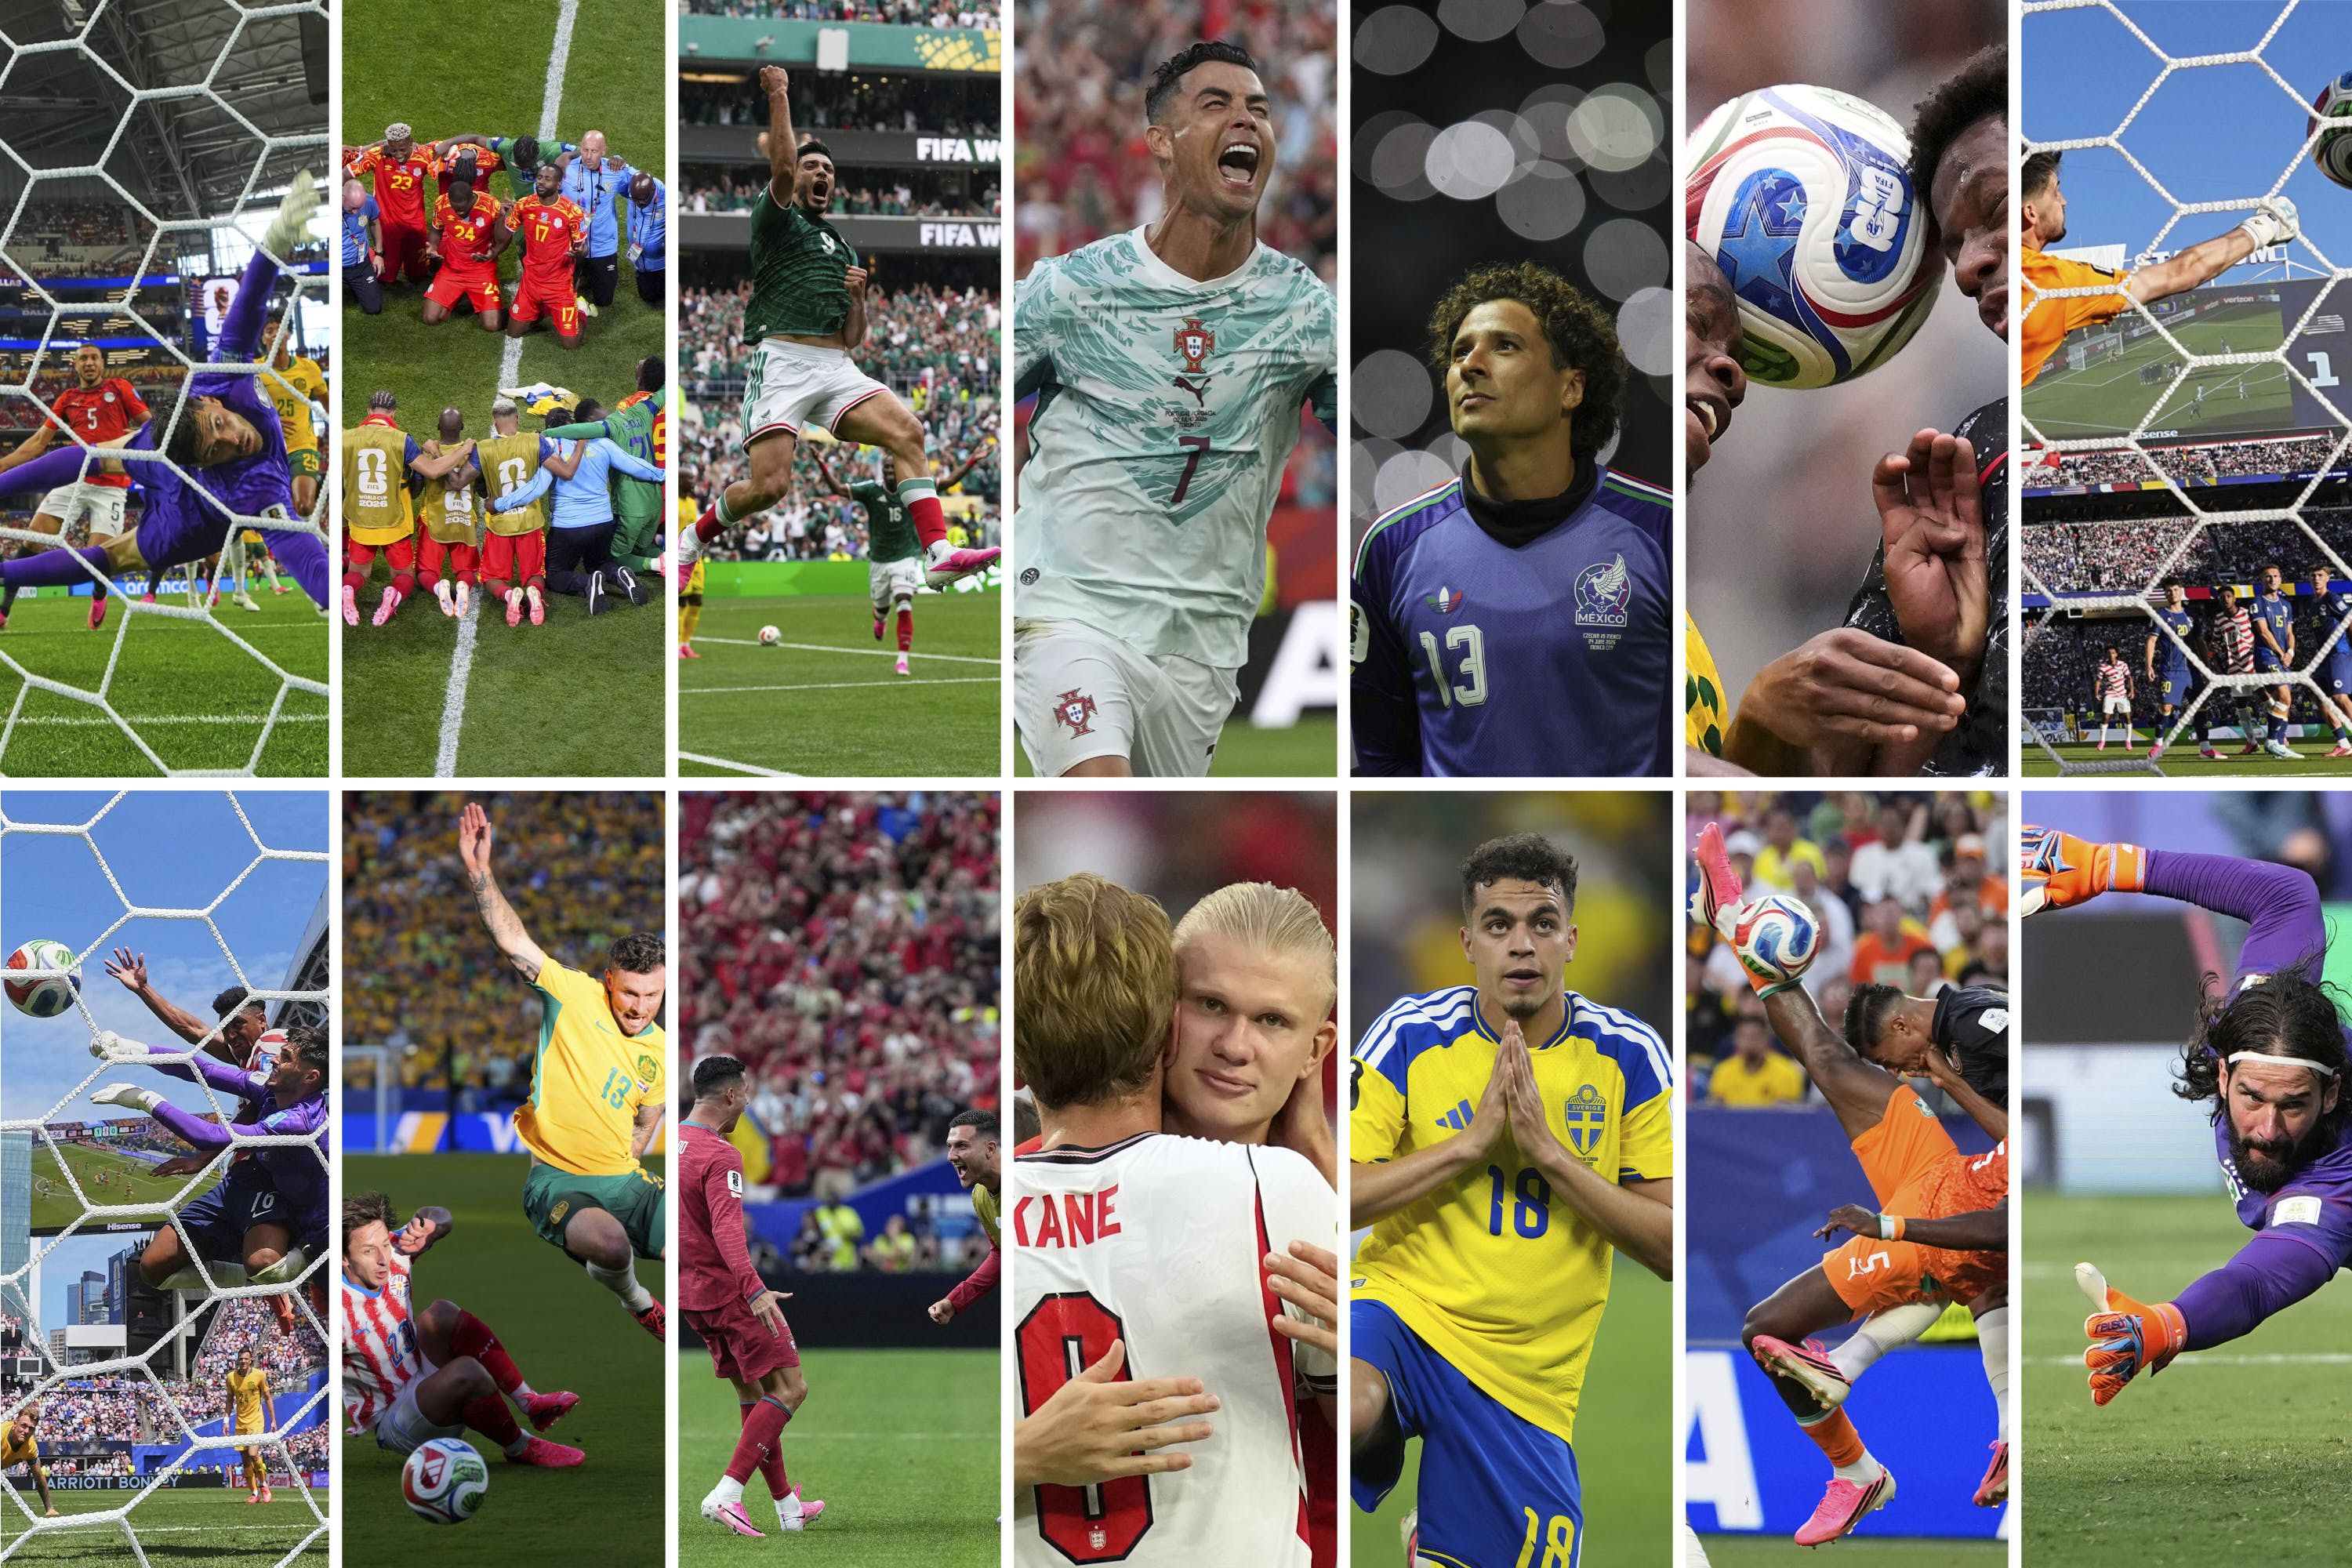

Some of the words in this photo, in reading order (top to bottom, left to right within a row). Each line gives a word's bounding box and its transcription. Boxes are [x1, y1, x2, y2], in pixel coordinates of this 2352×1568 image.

[916, 138, 973, 162] FIFA
[390, 175, 413, 190] 23
[454, 225, 476, 241] 24
[535, 224, 550, 242] 17
[920, 223, 976, 246] FIFA
[819, 231, 835, 256] 9
[482, 282, 500, 295] 24
[562, 307, 575, 322] 17
[2307, 351, 2340, 387] 1
[277, 399, 295, 417] 25
[87, 408, 97, 430] 5
[2131, 430, 2178, 439] isense
[301, 452, 319, 471] 25
[1171, 436, 1210, 503] 7
[111, 502, 120, 521] 5
[888, 507, 902, 521] 16
[445, 517, 472, 526] 2026
[1578, 612, 1624, 624] MÉXICO
[2275, 615, 2283, 627] 15
[2177, 624, 2188, 636] 20
[1420, 624, 1489, 709] 13
[2161, 681, 2172, 693] 20
[601, 1067, 632, 1109] 13
[1488, 1165, 1550, 1239] 18
[1014, 1182, 1121, 1248] KANE
[107, 1221, 142, 1231] Hisense
[1857, 1251, 1890, 1274] 5
[387, 1319, 416, 1367] 23
[32, 1476, 114, 1490] ARRIOTT
[1519, 1504, 1576, 1568] 18
